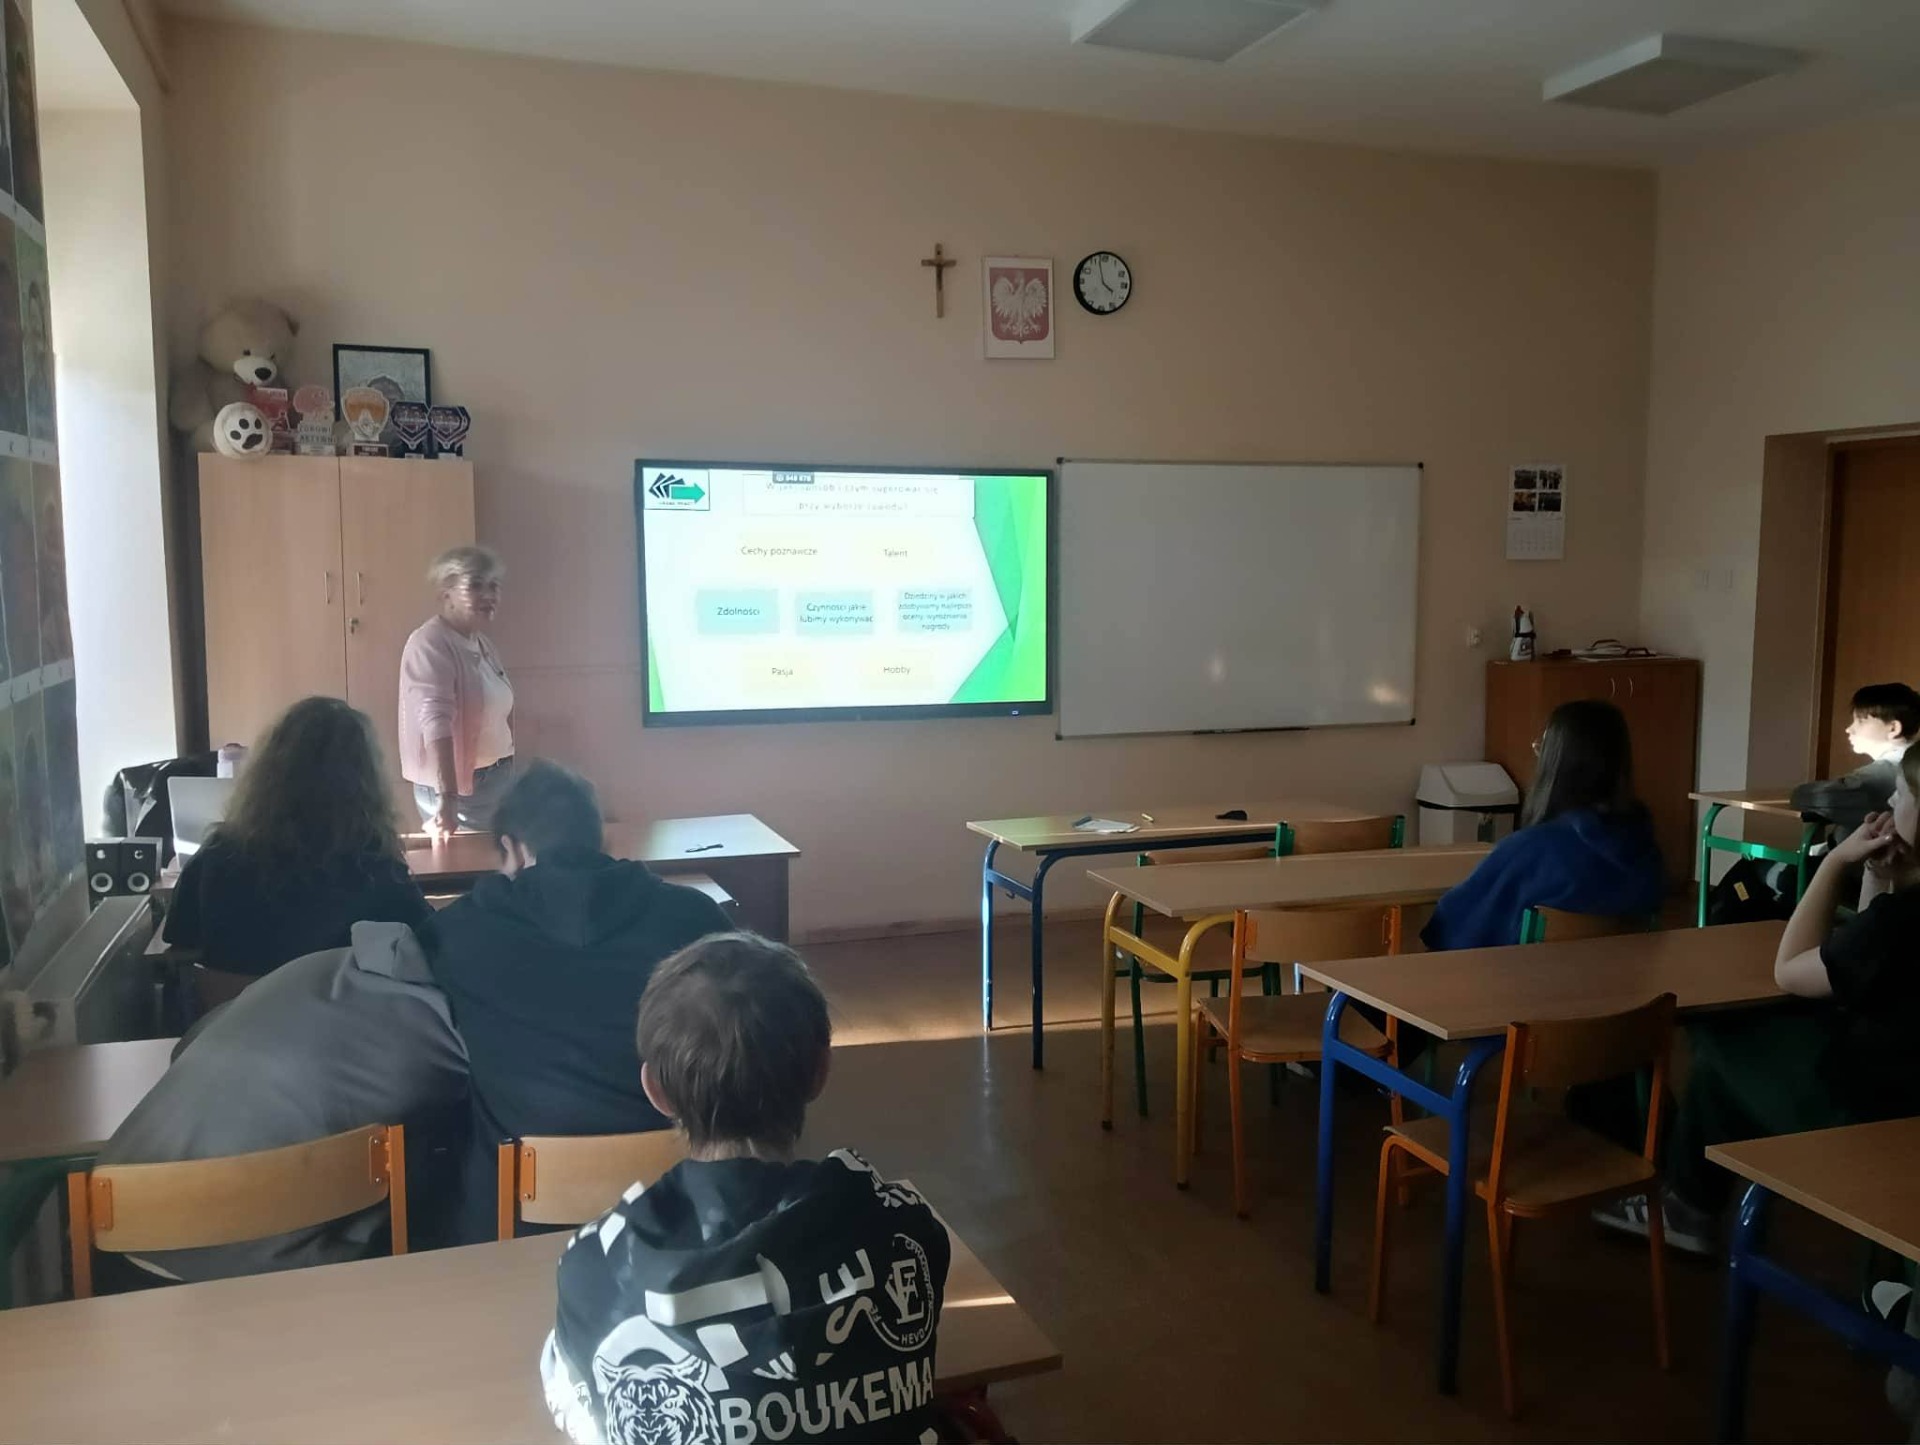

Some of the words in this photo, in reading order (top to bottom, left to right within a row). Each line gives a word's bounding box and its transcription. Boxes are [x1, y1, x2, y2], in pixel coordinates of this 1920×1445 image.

[740, 546, 768, 558] Cechy
[883, 548, 908, 558] Talent
[716, 606, 761, 617] Zdolności
[771, 667, 794, 678] Pasja
[883, 666, 911, 676] Hobby
